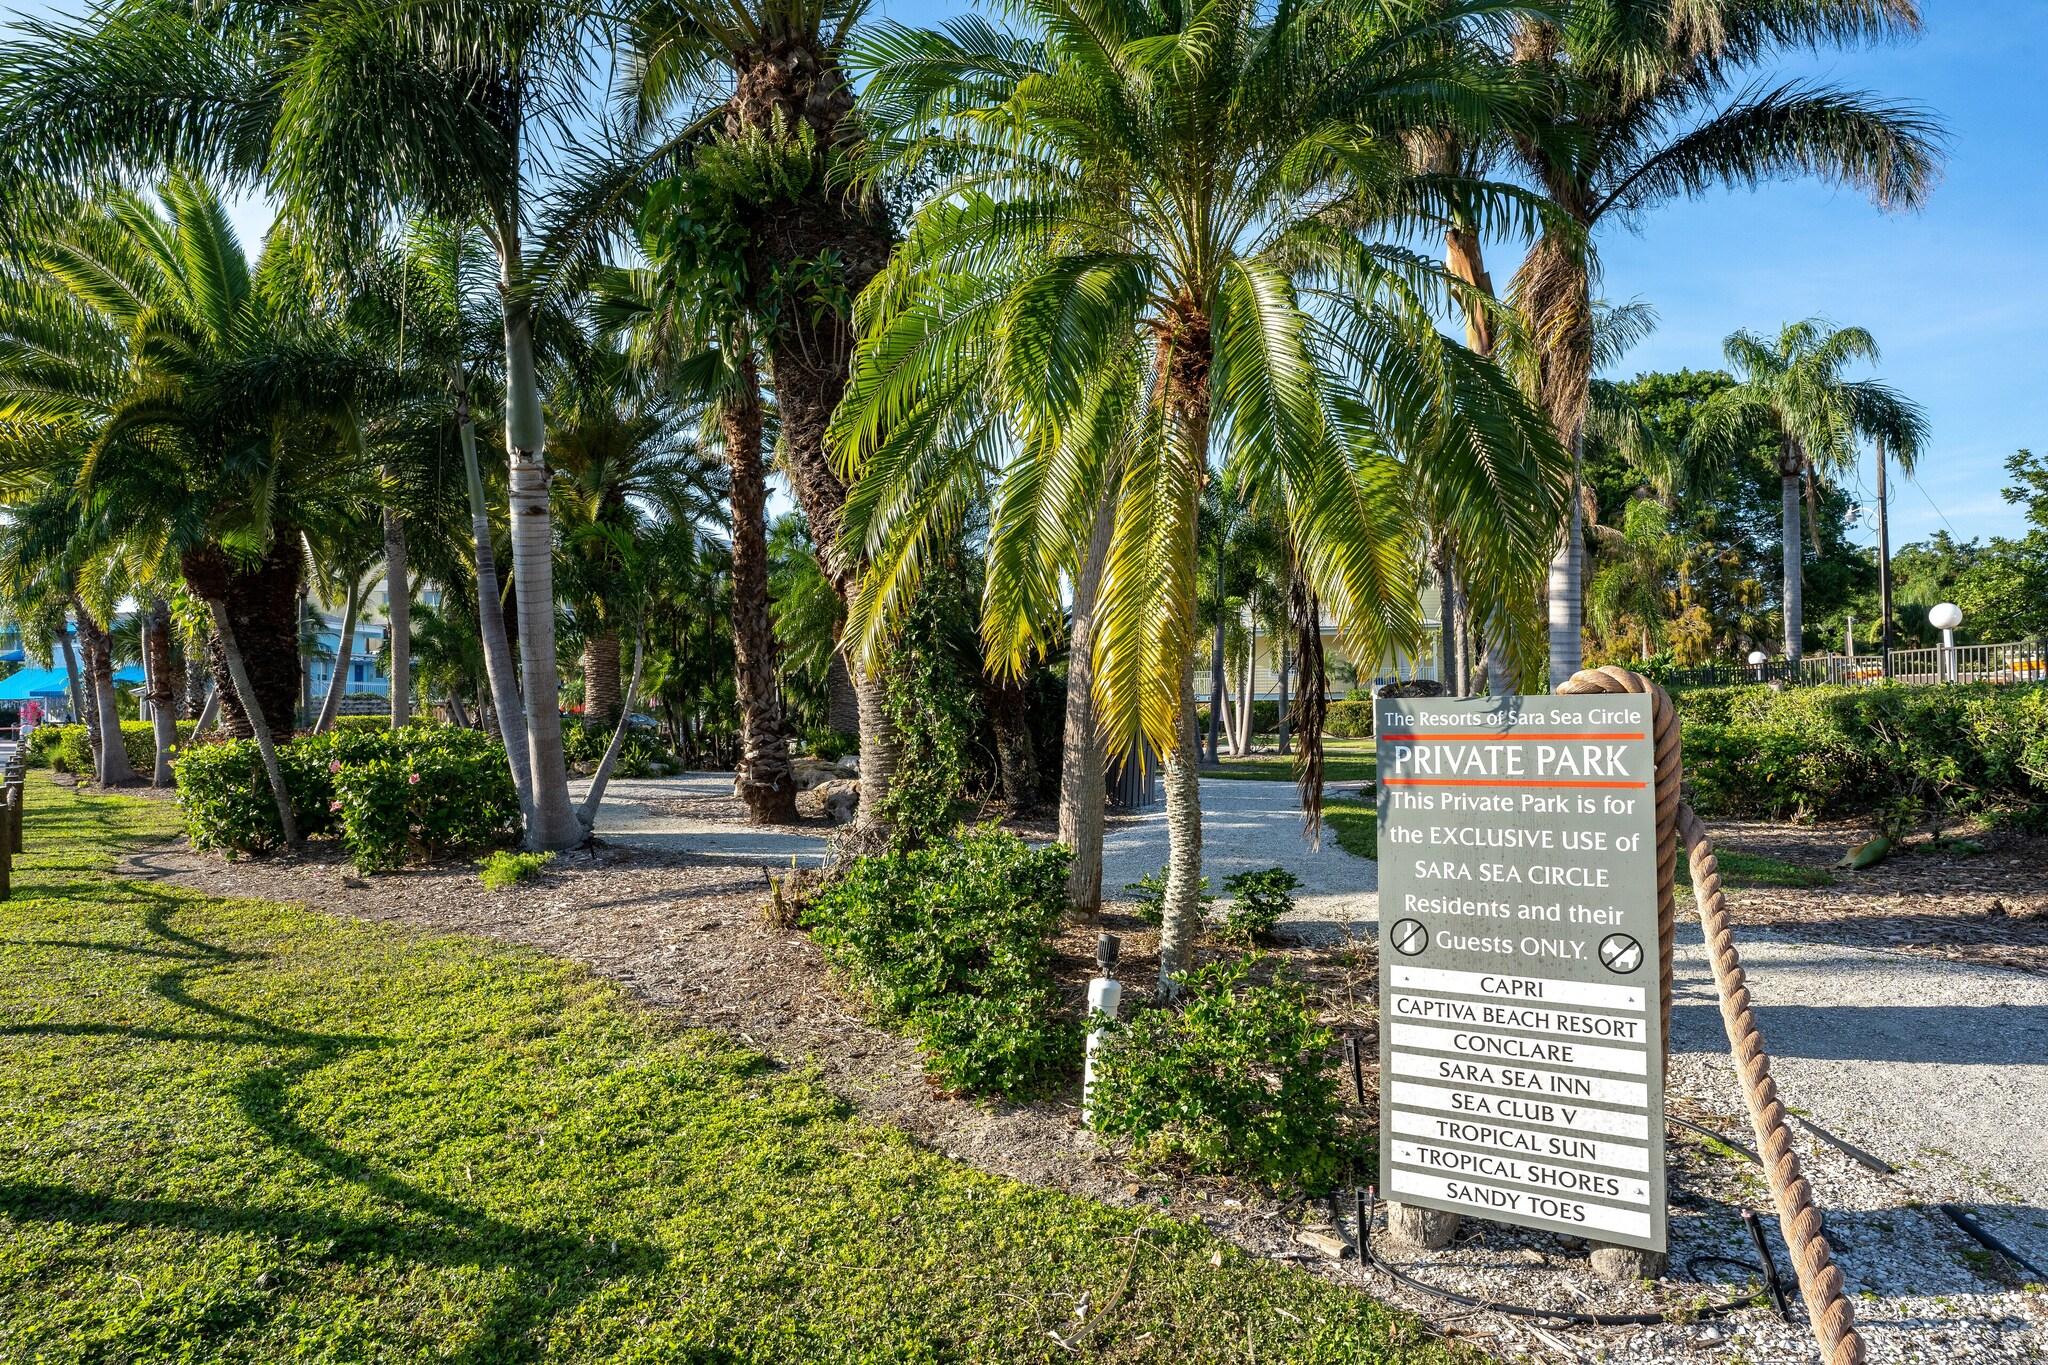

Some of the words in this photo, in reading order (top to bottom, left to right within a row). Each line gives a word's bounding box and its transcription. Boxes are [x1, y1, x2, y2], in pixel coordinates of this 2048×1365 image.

[1385, 712, 1414, 726] The
[1420, 712, 1480, 726] Resorts
[1487, 711, 1504, 725] of
[1509, 710, 1544, 725] Sara
[1551, 709, 1582, 725] Sea
[1588, 708, 1640, 724] Circle
[1394, 746, 1524, 776] PRIVATE
[1538, 745, 1630, 776] PARK
[1392, 792, 1434, 810] This
[1442, 792, 1513, 812] Private
[1522, 794, 1569, 814] Park
[1578, 795, 1596, 814] is
[1604, 796, 1636, 814] for
[1390, 826, 1423, 844] the
[1430, 826, 1554, 848] EXCLUSIVE
[1562, 831, 1607, 850] USE
[1616, 832, 1640, 852] of
[1415, 860, 1472, 880] SARA
[1480, 864, 1522, 883] SEA
[1528, 866, 1609, 888] CIRCLE
[1405, 894, 1510, 918] Residents
[1518, 902, 1560, 922] and
[1569, 904, 1624, 925] their
[1436, 930, 1512, 954] Guests
[1520, 938, 1588, 960] ONLY.
[1480, 976, 1544, 998] CAPRI
[1397, 998, 1476, 1022] CAPTIVA
[1483, 1007, 1549, 1030] BEACH
[1557, 1014, 1638, 1038] RESORT
[1454, 1034, 1574, 1062] CONCLARE
[1439, 1062, 1494, 1084] SARA
[1502, 1070, 1542, 1090] SEA
[1551, 1076, 1591, 1096] INN
[1451, 1093, 1491, 1114] SEA
[1497, 1099, 1554, 1122] CLUB
[1562, 1108, 1577, 1124] V
[1436, 1120, 1542, 1152] TROPICAL
[1548, 1138, 1596, 1160] SUN
[1416, 1147, 1522, 1180] TROPICAL
[1528, 1166, 1619, 1196] SHORES
[1446, 1182, 1520, 1210] SANDY
[1528, 1197, 1586, 1222] TOES
